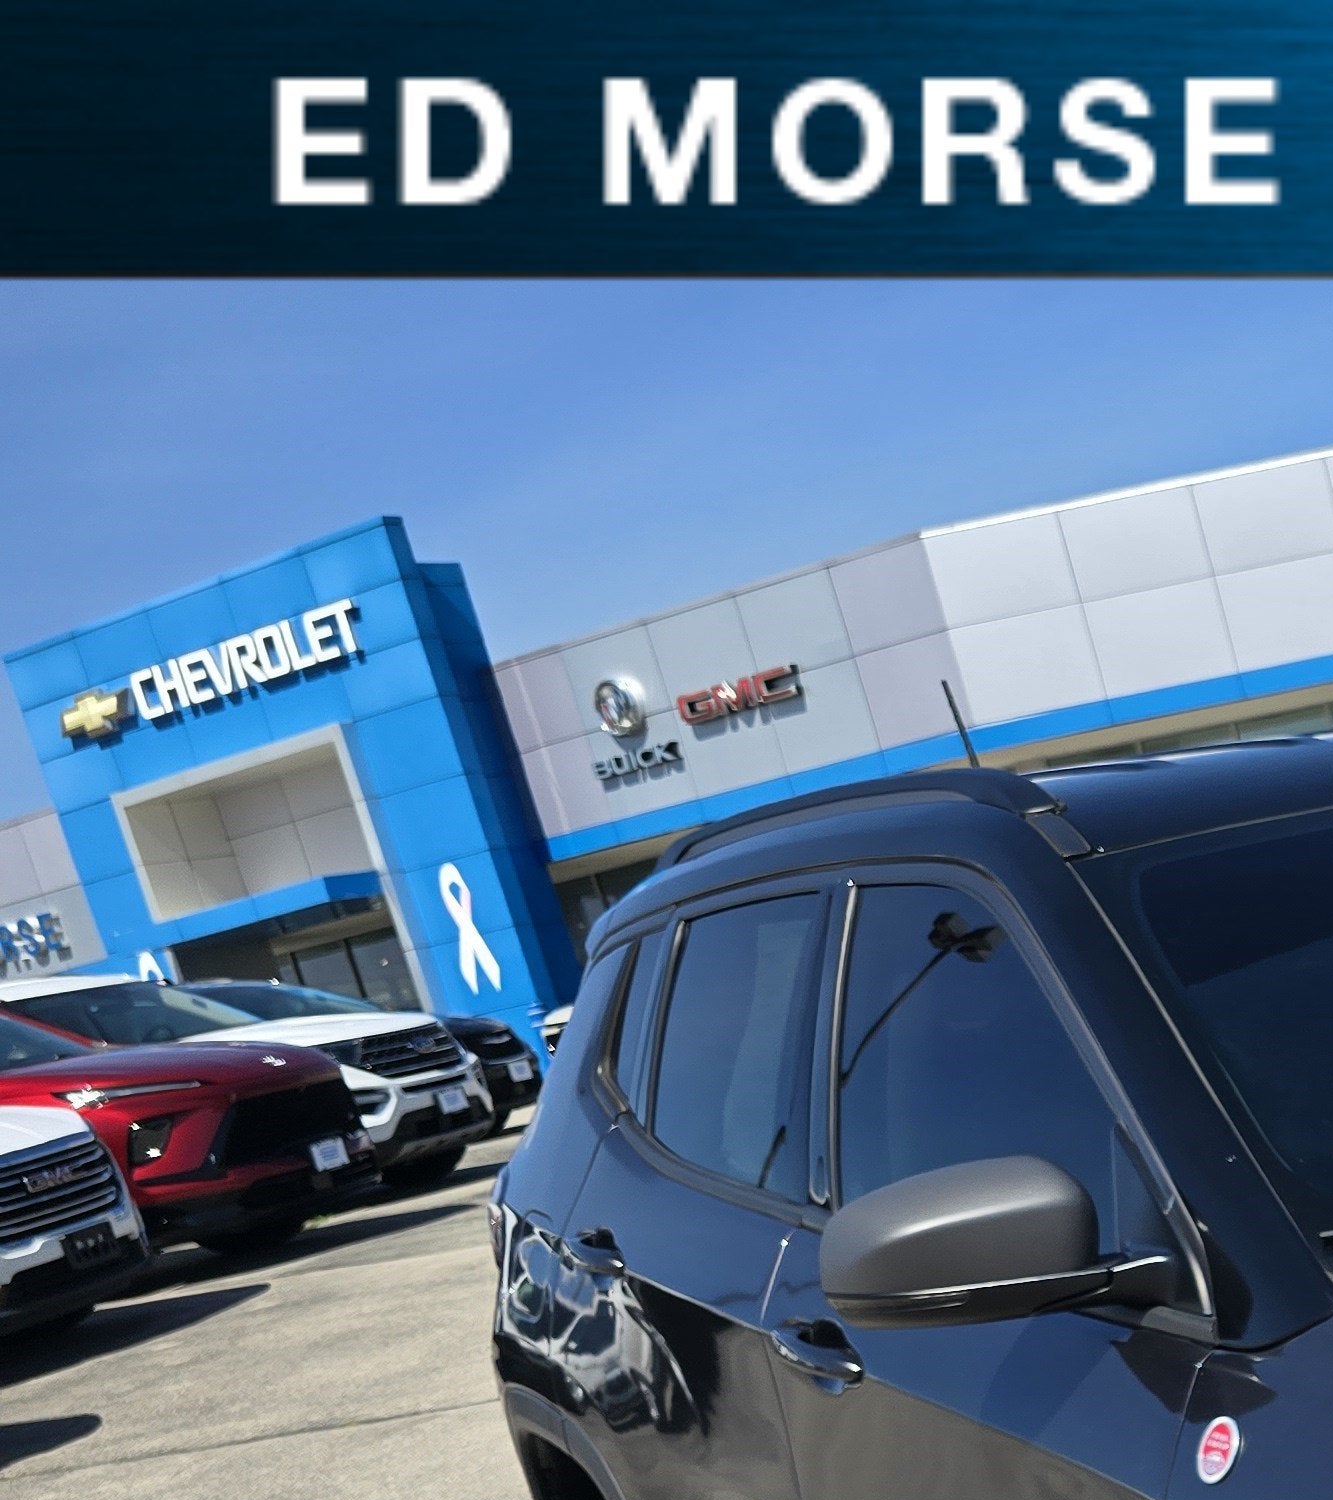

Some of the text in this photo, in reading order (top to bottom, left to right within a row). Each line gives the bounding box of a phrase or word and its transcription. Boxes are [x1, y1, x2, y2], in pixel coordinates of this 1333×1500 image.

[130, 597, 358, 721] CHEVROLET
[676, 664, 800, 726] GMC
[593, 741, 682, 780] BUICK
